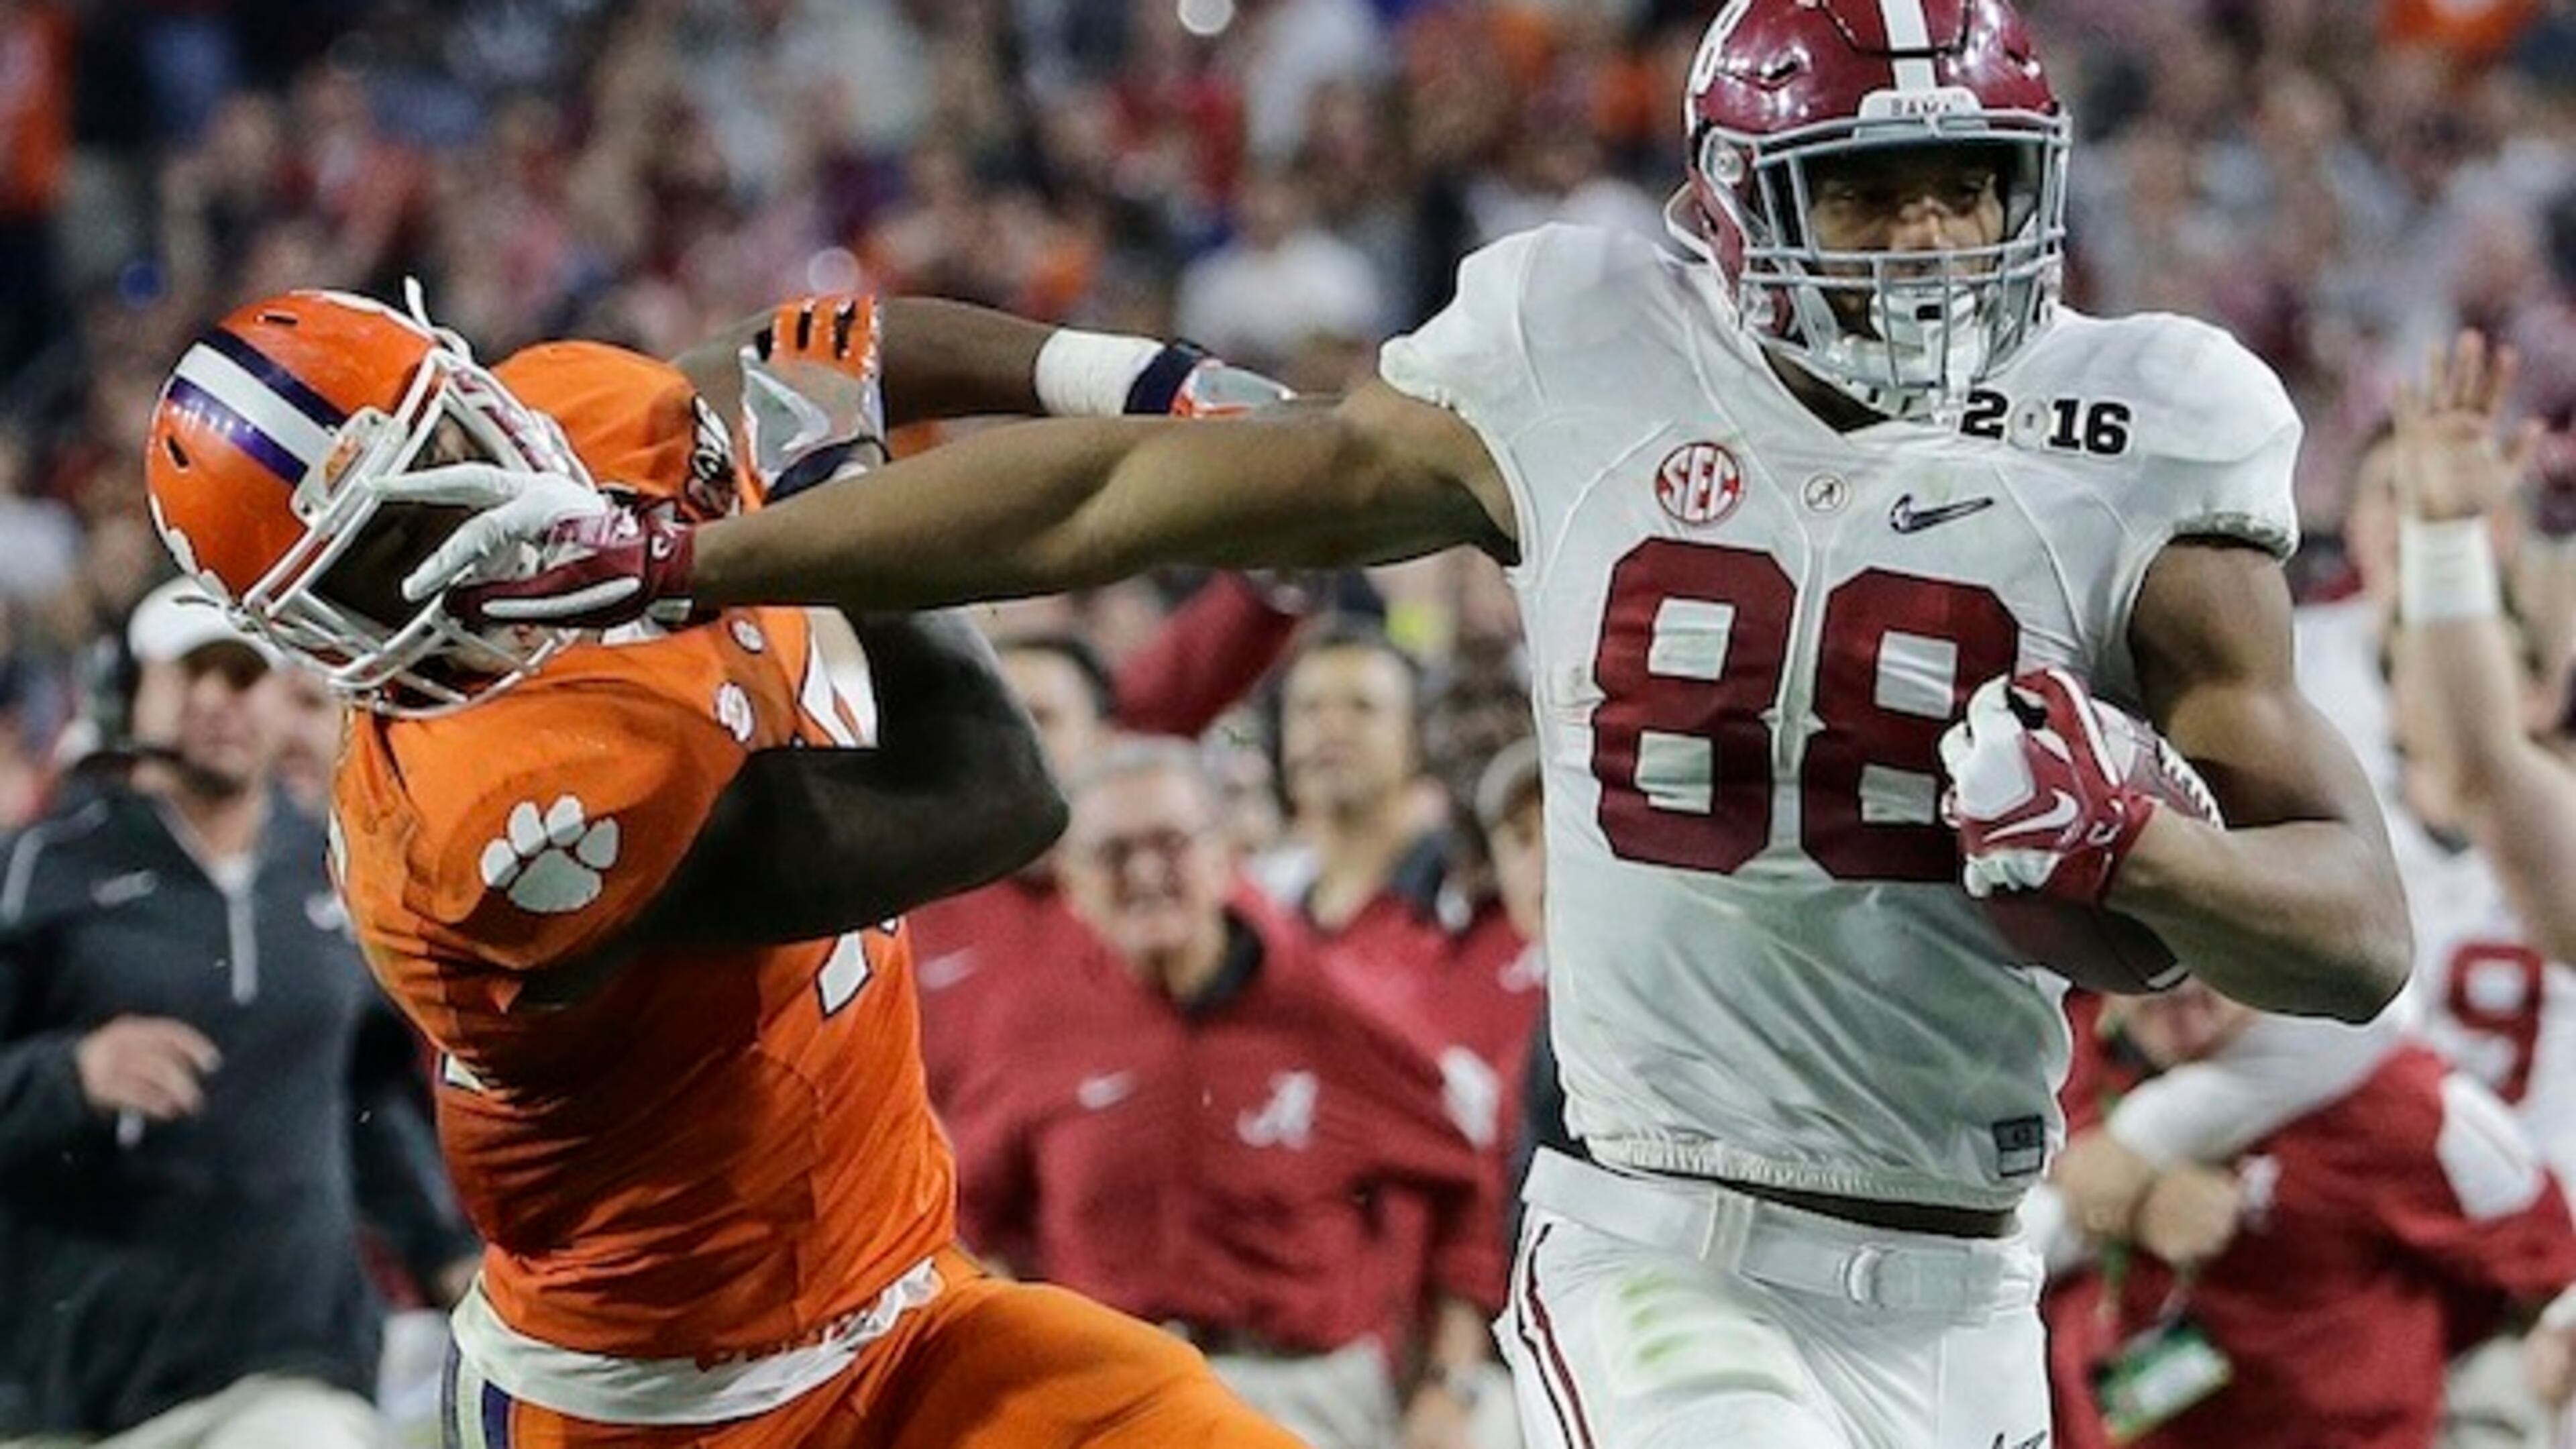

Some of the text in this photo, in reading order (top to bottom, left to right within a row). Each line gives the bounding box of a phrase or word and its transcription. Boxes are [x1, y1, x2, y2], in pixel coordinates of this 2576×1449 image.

[1960, 389, 2131, 455] 2016
[1658, 444, 1739, 522] SEC
[1591, 537, 2019, 882] 88
[2446, 942, 2542, 1106] 9
